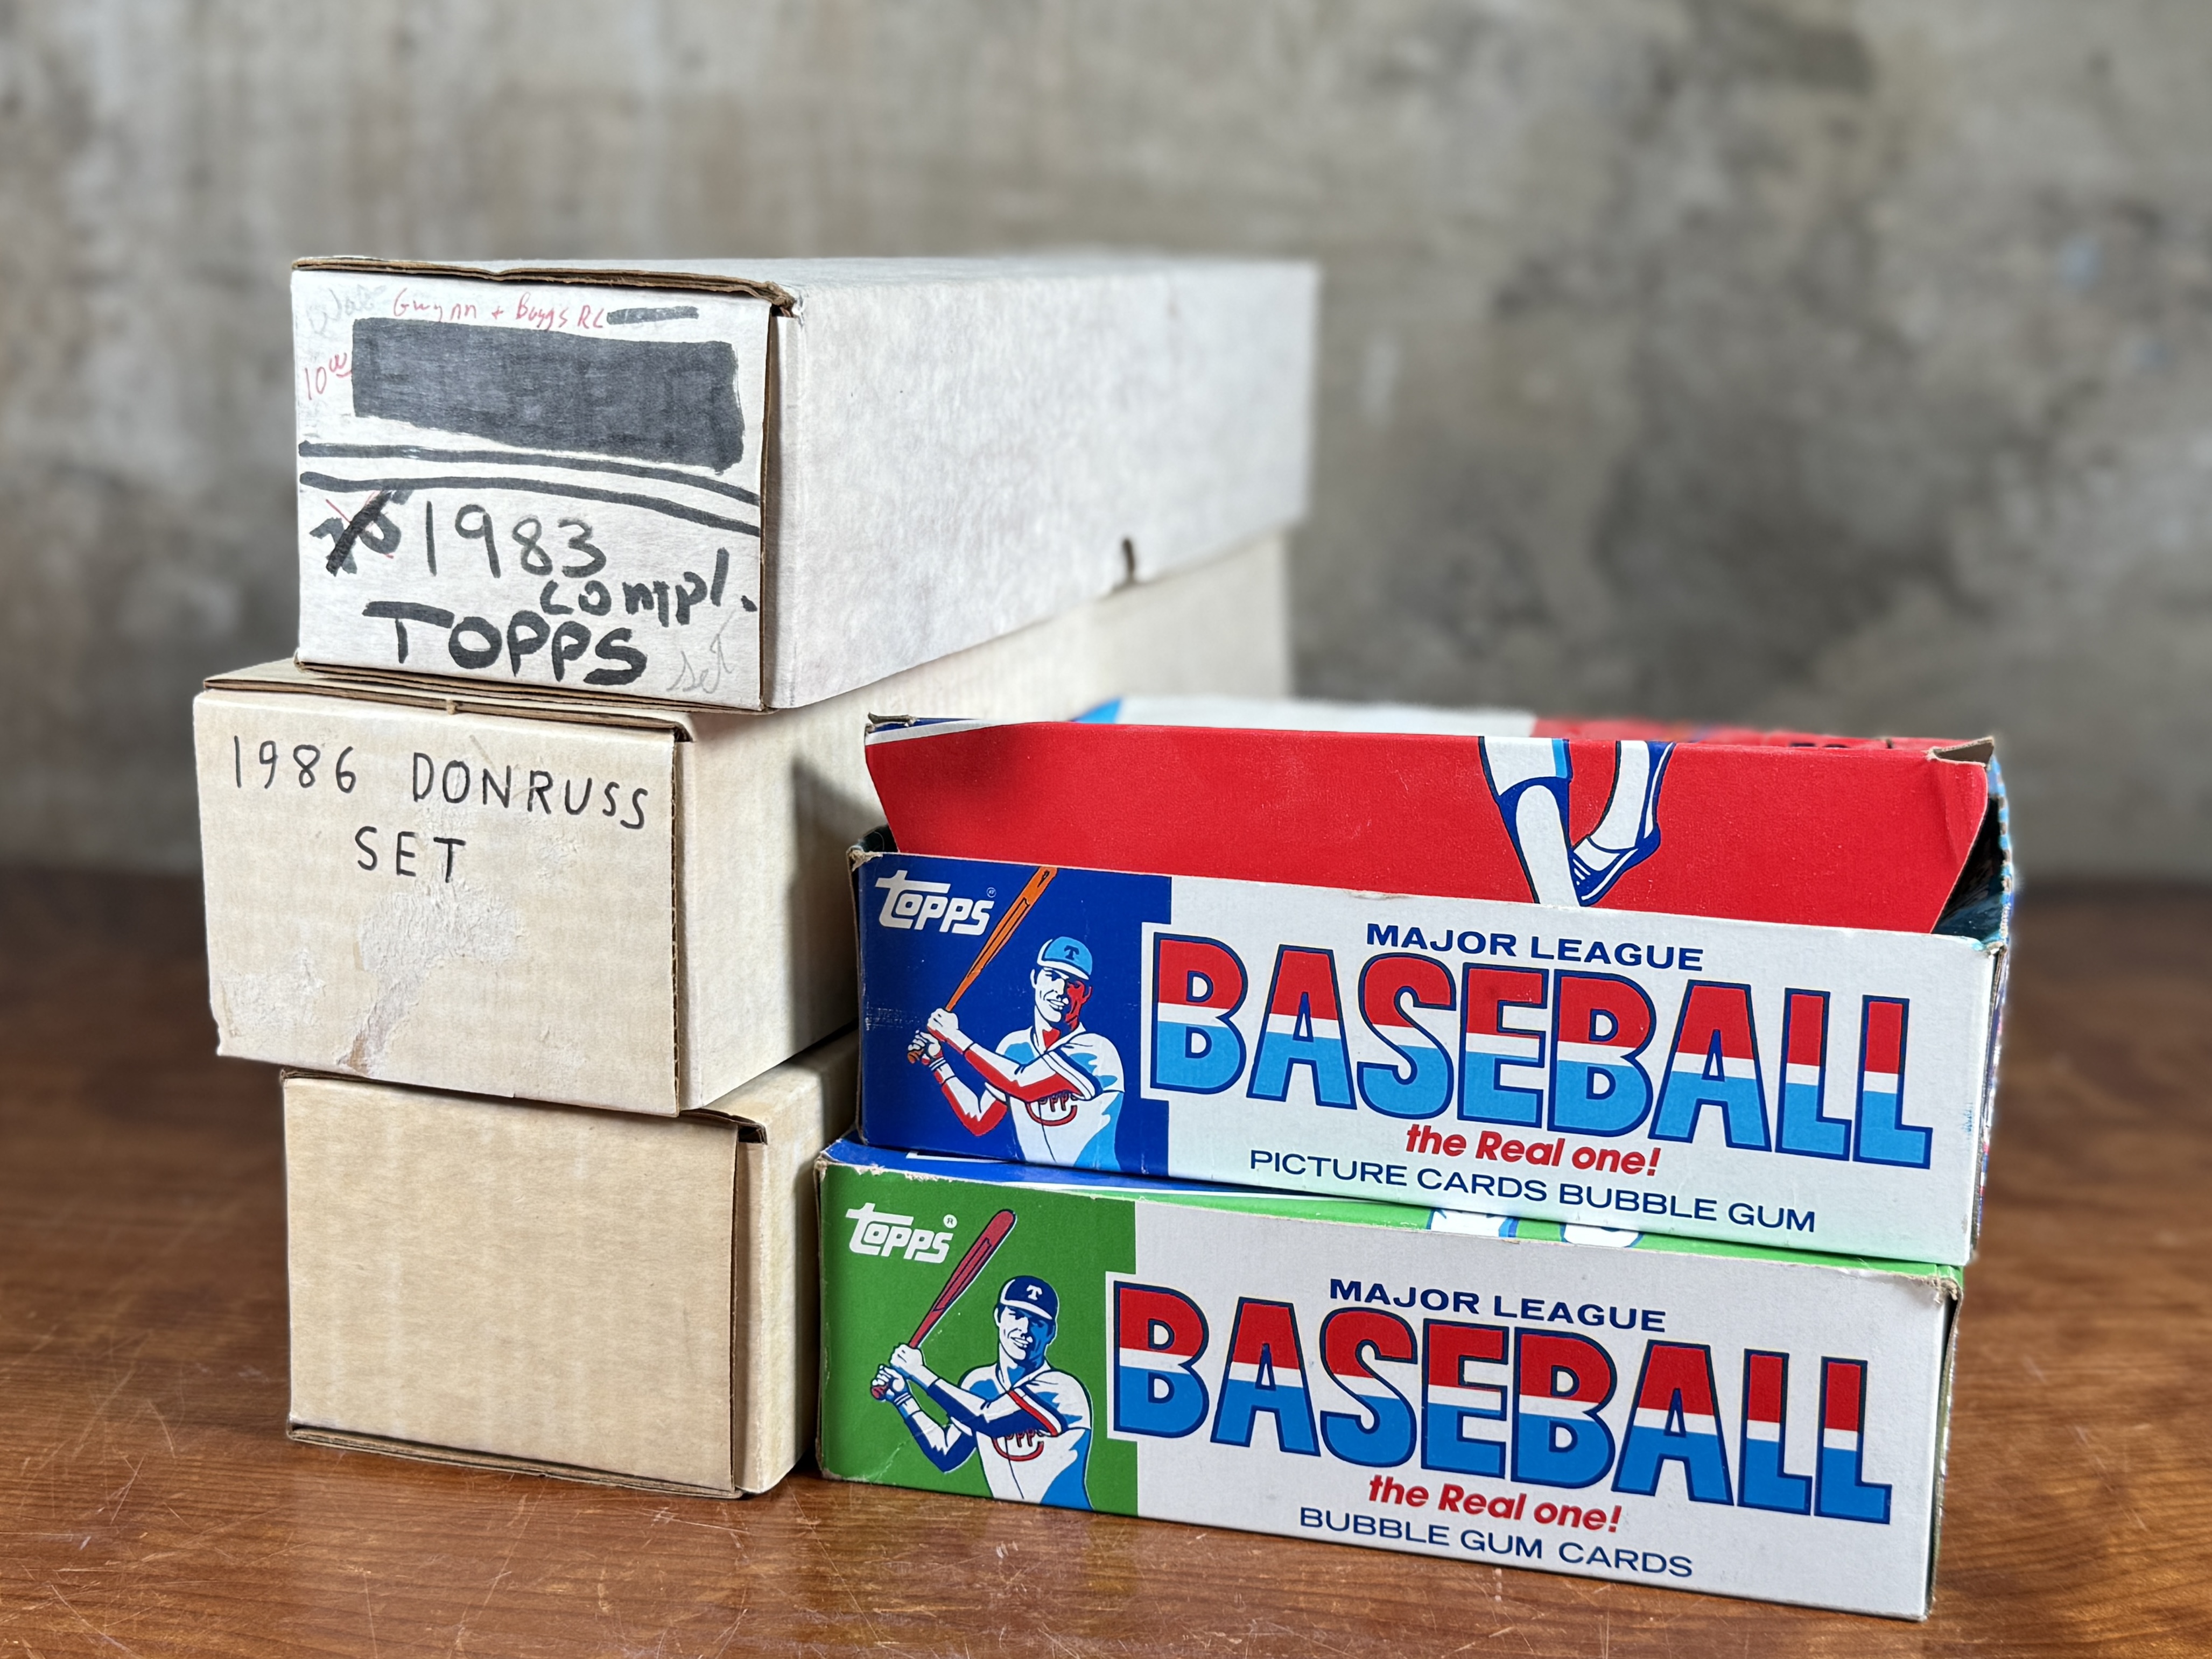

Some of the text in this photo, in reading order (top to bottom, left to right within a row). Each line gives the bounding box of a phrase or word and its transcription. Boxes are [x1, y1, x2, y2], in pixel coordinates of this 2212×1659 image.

[425, 500, 607, 579] 1983
[362, 600, 648, 685] TOPPS
[233, 735, 649, 830] 1986 DONRUSS
[354, 825, 466, 883] SET
[1367, 923, 1704, 972] MAJOR LEAGUE
[1150, 932, 1933, 1170] BASEBALL
[1406, 1124, 1662, 1177] the Real one!
[1250, 1150, 1816, 1233] PICTURE CARDS BUBBLE GUM
[1330, 1279, 1666, 1332] MAJOR LEAGUE
[1113, 1281, 1893, 1524] BASEBALL
[1369, 1474, 1623, 1533] the Real one!
[1300, 1507, 1693, 1577] BUBBLE GUM CARDS
